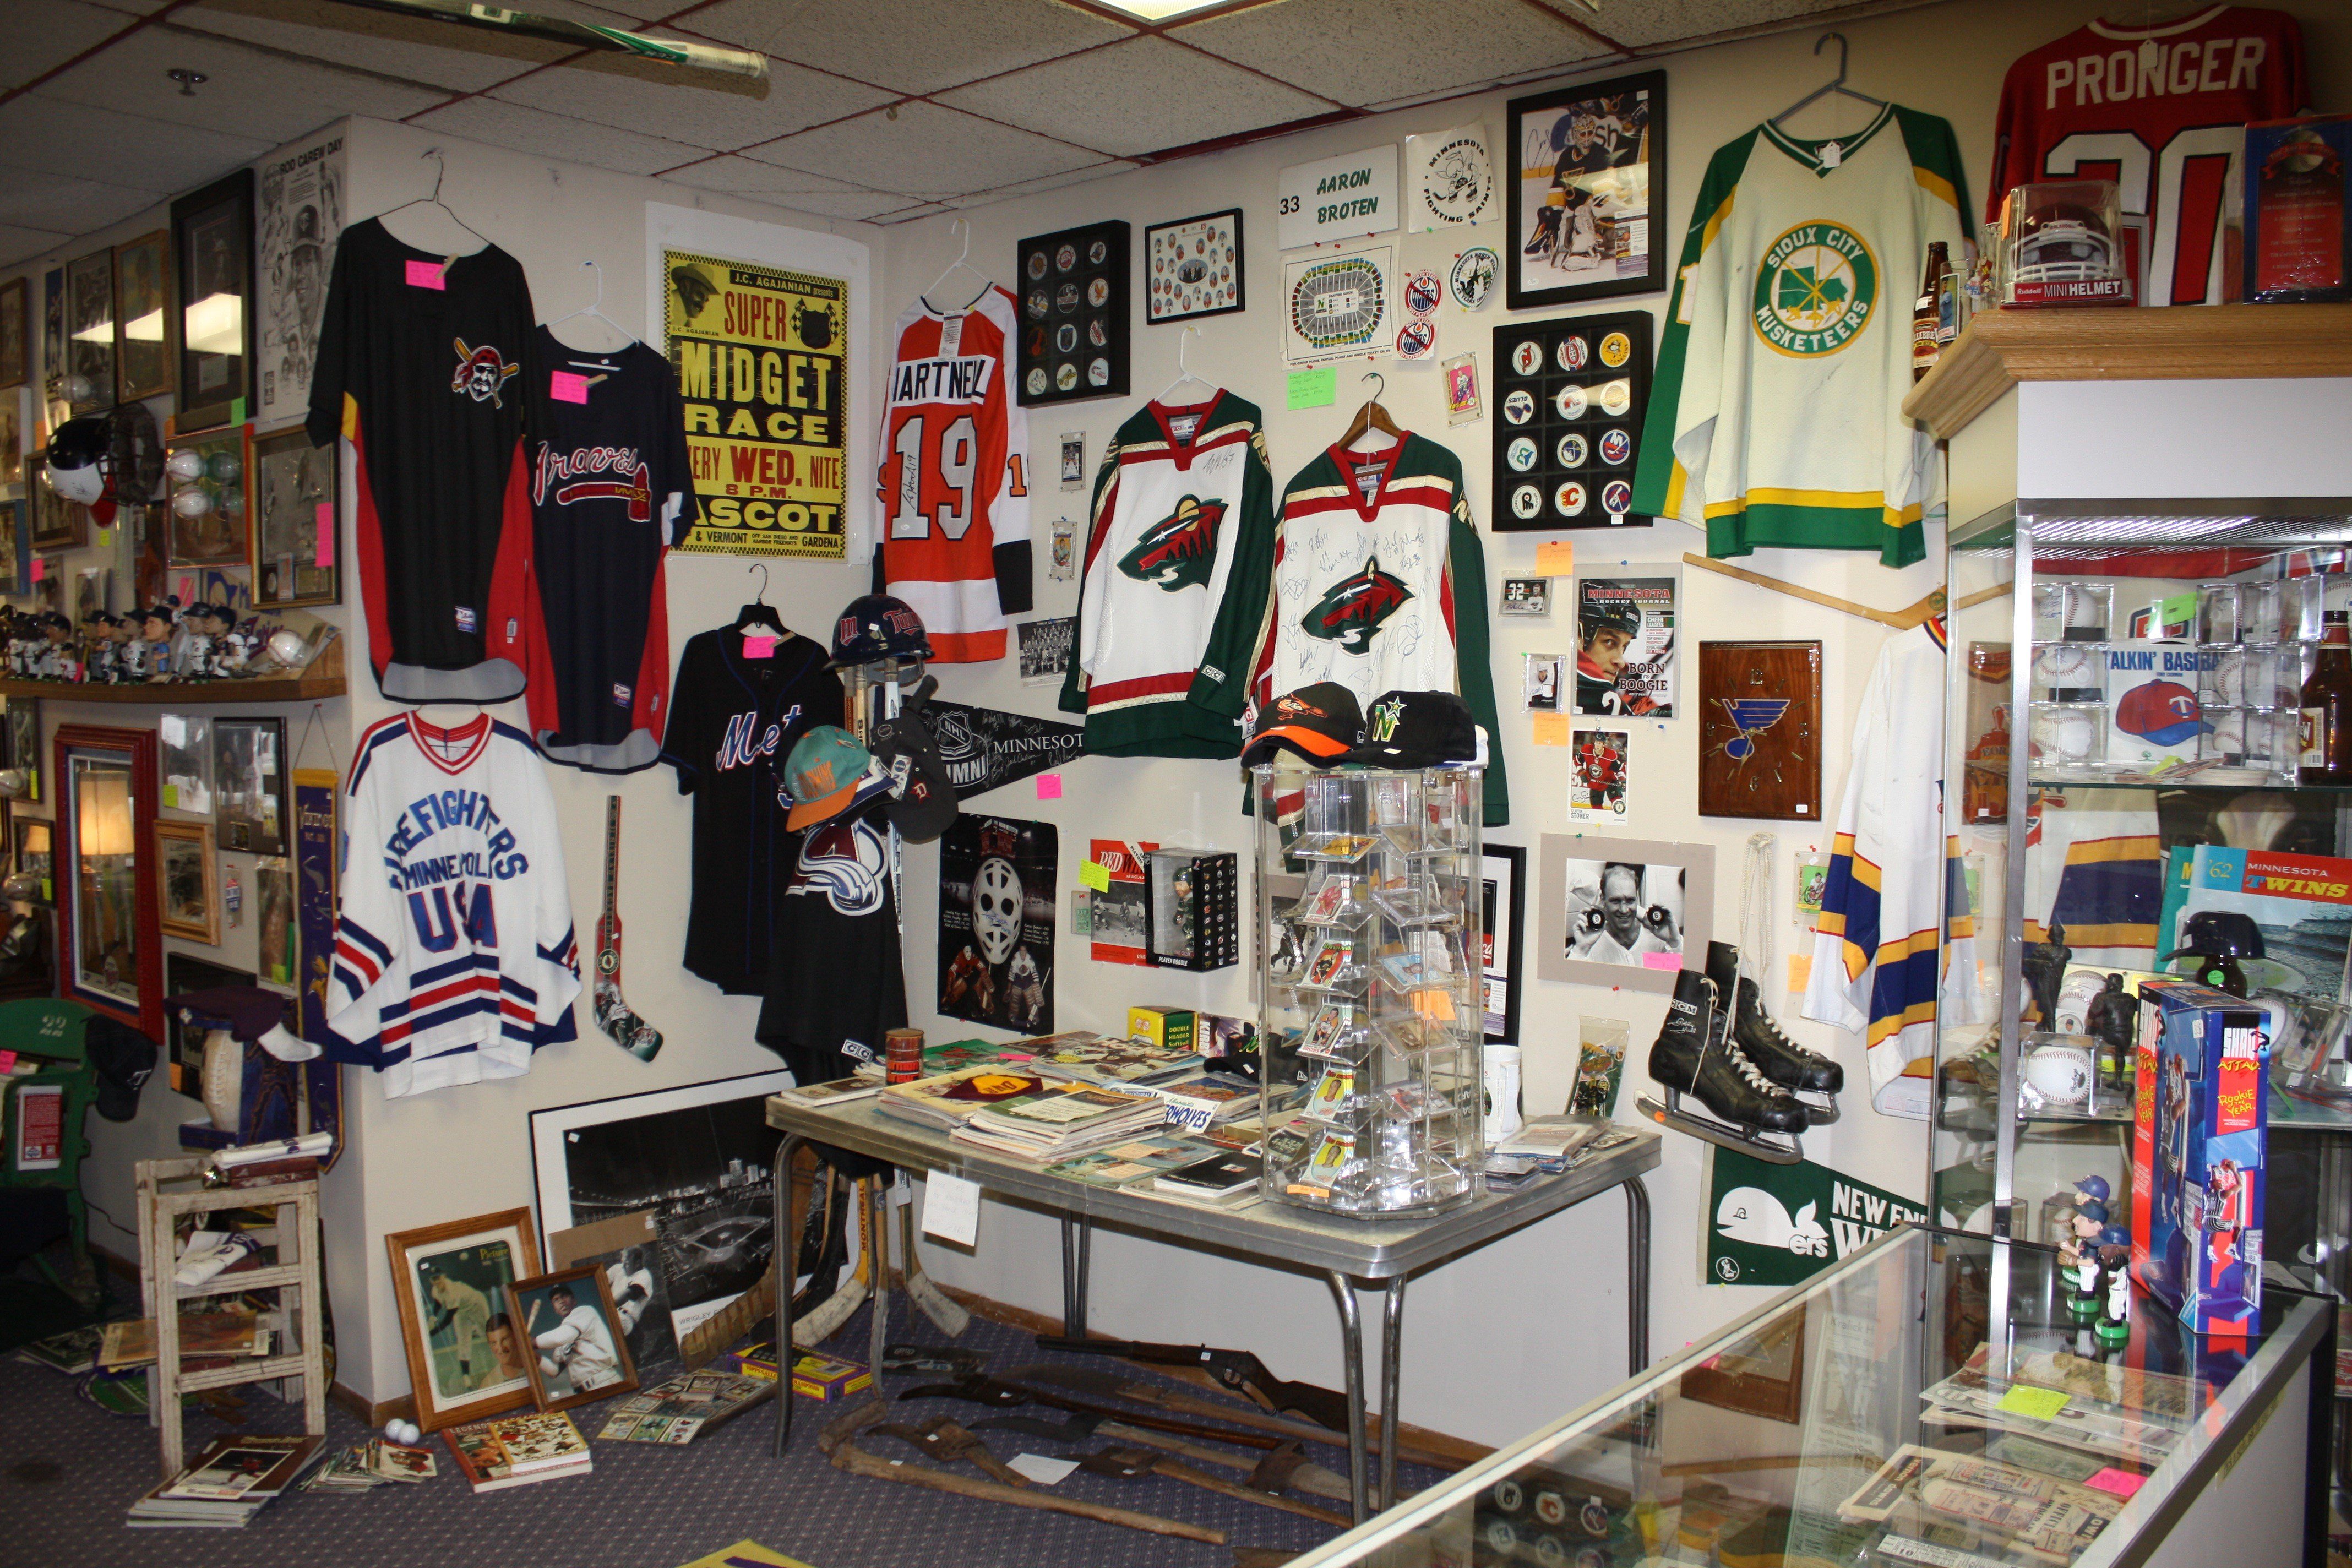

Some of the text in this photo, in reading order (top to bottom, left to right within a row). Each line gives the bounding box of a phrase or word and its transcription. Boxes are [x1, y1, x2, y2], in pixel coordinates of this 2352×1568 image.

[2046, 37, 2266, 110] PRONGER
[280, 137, 344, 174] ROD CAREW DAY
[1428, 138, 1485, 168] MINNESOTA
[1316, 167, 1371, 195] AARON
[1280, 195, 1300, 215] 33
[1317, 195, 1379, 225] BROTEN
[1423, 176, 1492, 222] FIGHTING SAINTS
[1767, 226, 1864, 269] SIOUX CITY
[734, 273, 834, 298] J.C. AGAJANIAN presents
[2044, 285, 2067, 297] MINI
[2068, 281, 2120, 296] HELMET
[725, 290, 787, 342] SUPER
[1756, 299, 1868, 351] MUSKETEERS
[686, 328, 720, 337] AGAJANIAN
[680, 340, 831, 411] MIDGET
[684, 403, 829, 444] RACE
[729, 445, 802, 487] WED.
[810, 454, 840, 490] NITE
[891, 415, 979, 541] 19
[725, 483, 792, 499] 8 P.M.
[707, 531, 748, 545] VERMONT
[802, 536, 839, 548] GARDENA
[1507, 582, 1525, 601] 32
[1587, 588, 1671, 599] MINNESOTA
[1628, 662, 1666, 674] BORN
[2102, 650, 2157, 671] TALKIN'
[1619, 679, 1668, 691] BOOGIE
[943, 722, 967, 743] NHL
[1099, 851, 1124, 873] RED
[1130, 845, 1144, 864] PLAYOFF
[2247, 862, 2329, 878] MINNESOTA
[2245, 875, 2351, 899] TWINS
[1158, 956, 1188, 967] PLAYER BOBBLE
[1169, 1025, 1189, 1033] DOUBLE
[2223, 1028, 2256, 1060] SHAQ
[2217, 1060, 2260, 1071] ATTAQ
[1832, 1180, 1887, 1225] NEW
[1788, 1234, 1829, 1259] ers
[679, 1311, 711, 1325] WRIGLEY
